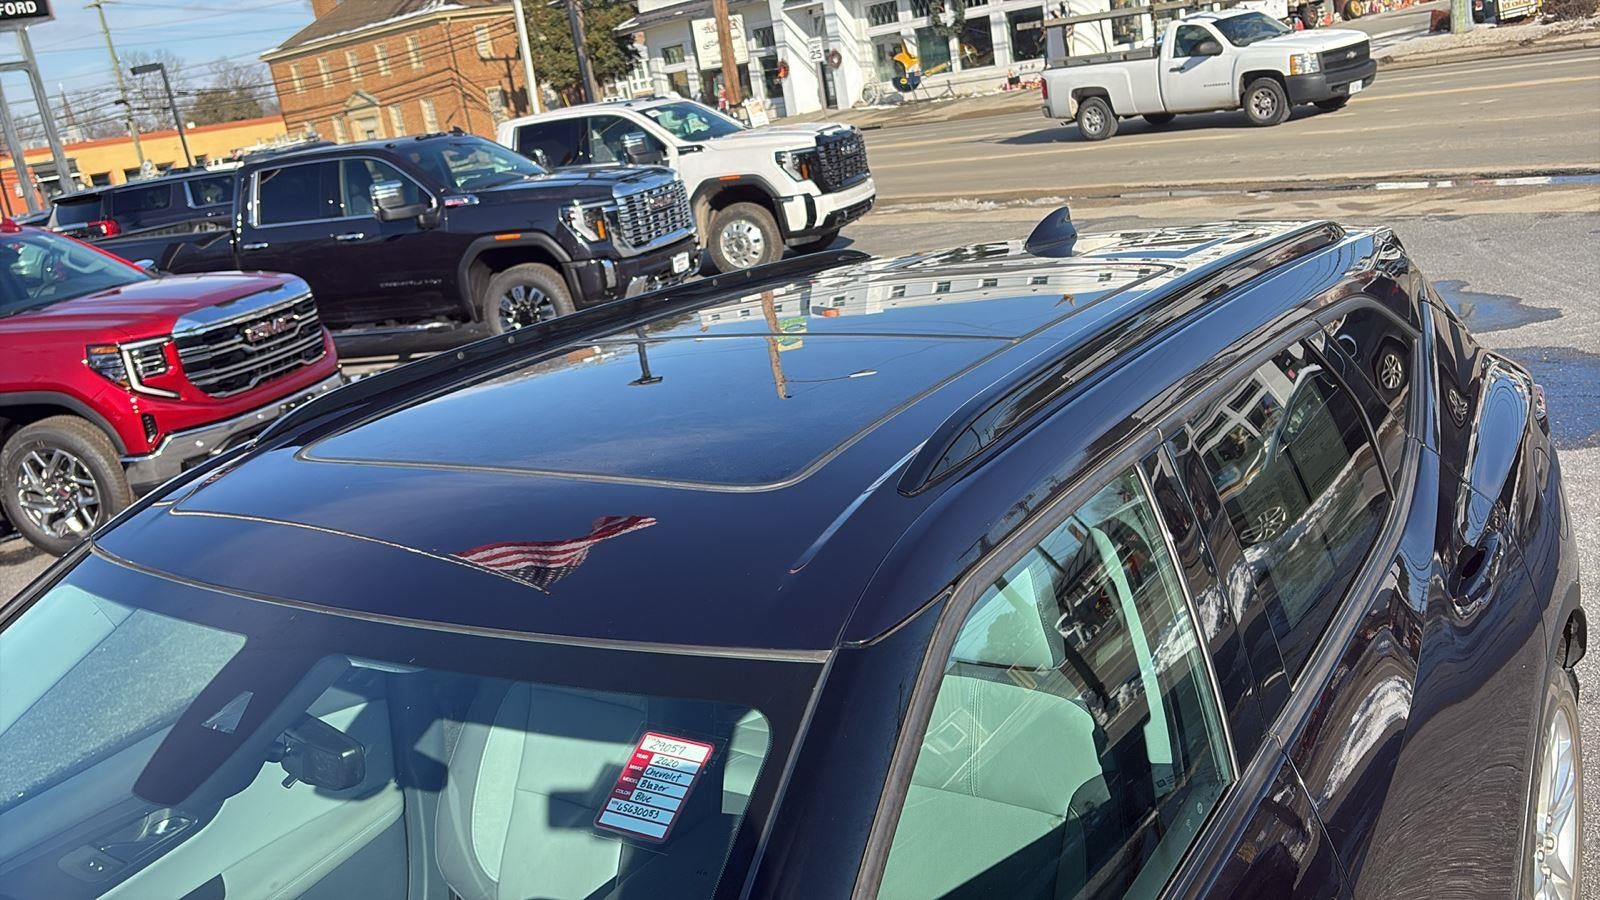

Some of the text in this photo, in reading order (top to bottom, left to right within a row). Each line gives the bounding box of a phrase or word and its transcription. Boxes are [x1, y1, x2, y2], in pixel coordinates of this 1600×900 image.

[809, 49, 822, 60] 25
[244, 313, 299, 342] GMC
[654, 756, 680, 769] 2020
[644, 767, 682, 783] Chevrolet
[639, 779, 670, 793] Blazer
[615, 788, 652, 804] COLOR Blue
